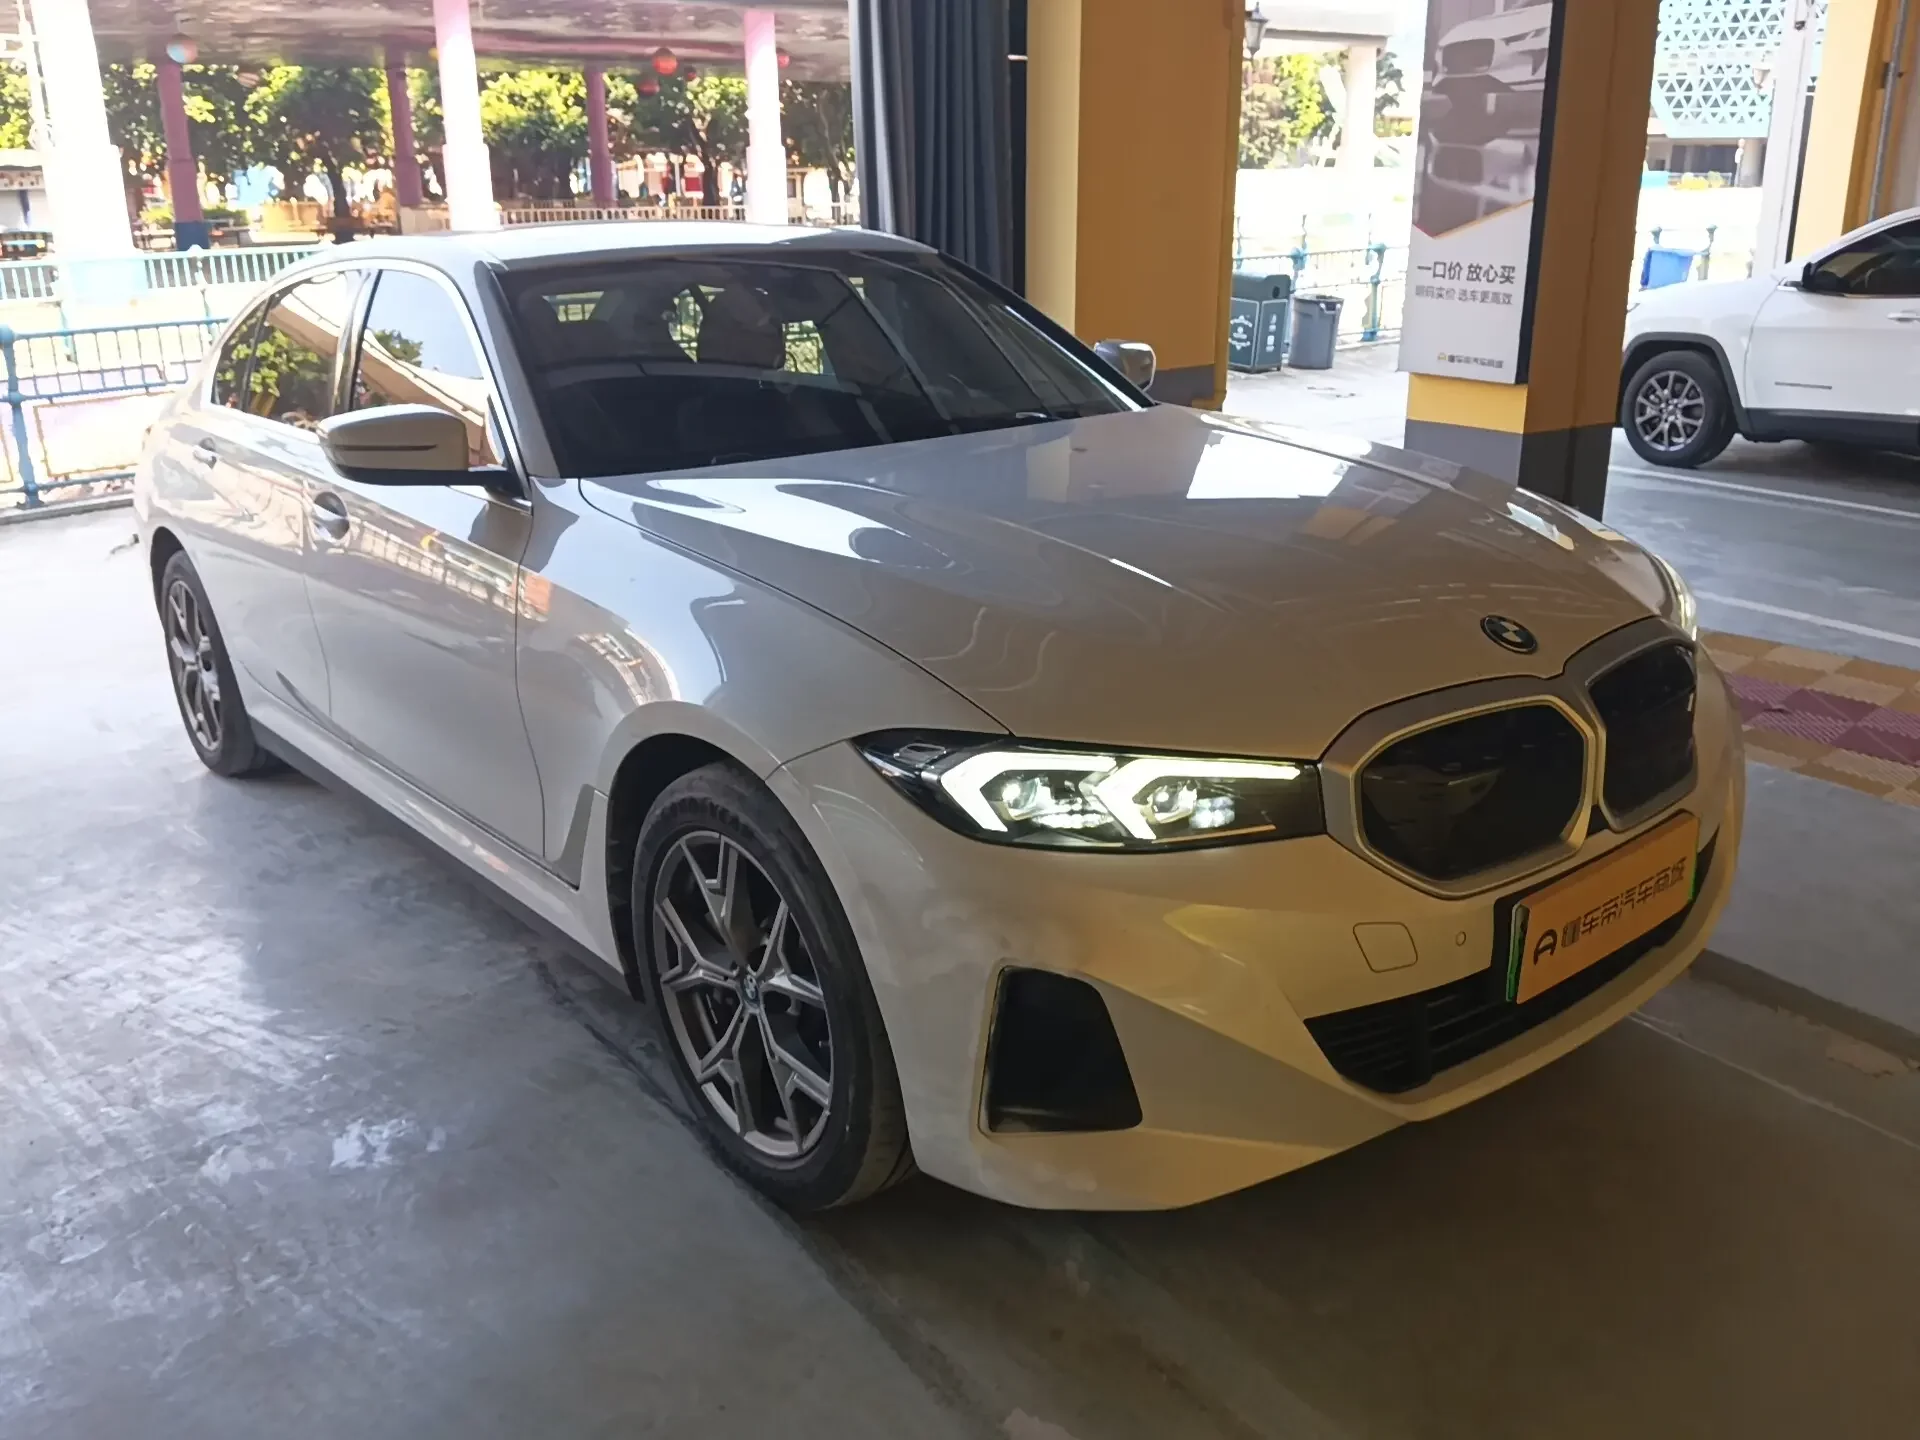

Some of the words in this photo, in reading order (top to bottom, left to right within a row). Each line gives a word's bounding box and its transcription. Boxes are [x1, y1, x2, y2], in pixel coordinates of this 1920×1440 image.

[1417, 261, 1463, 280] 一口价
[1466, 262, 1516, 284] 放心买
[1561, 856, 1687, 948] 车帝汽车商城
